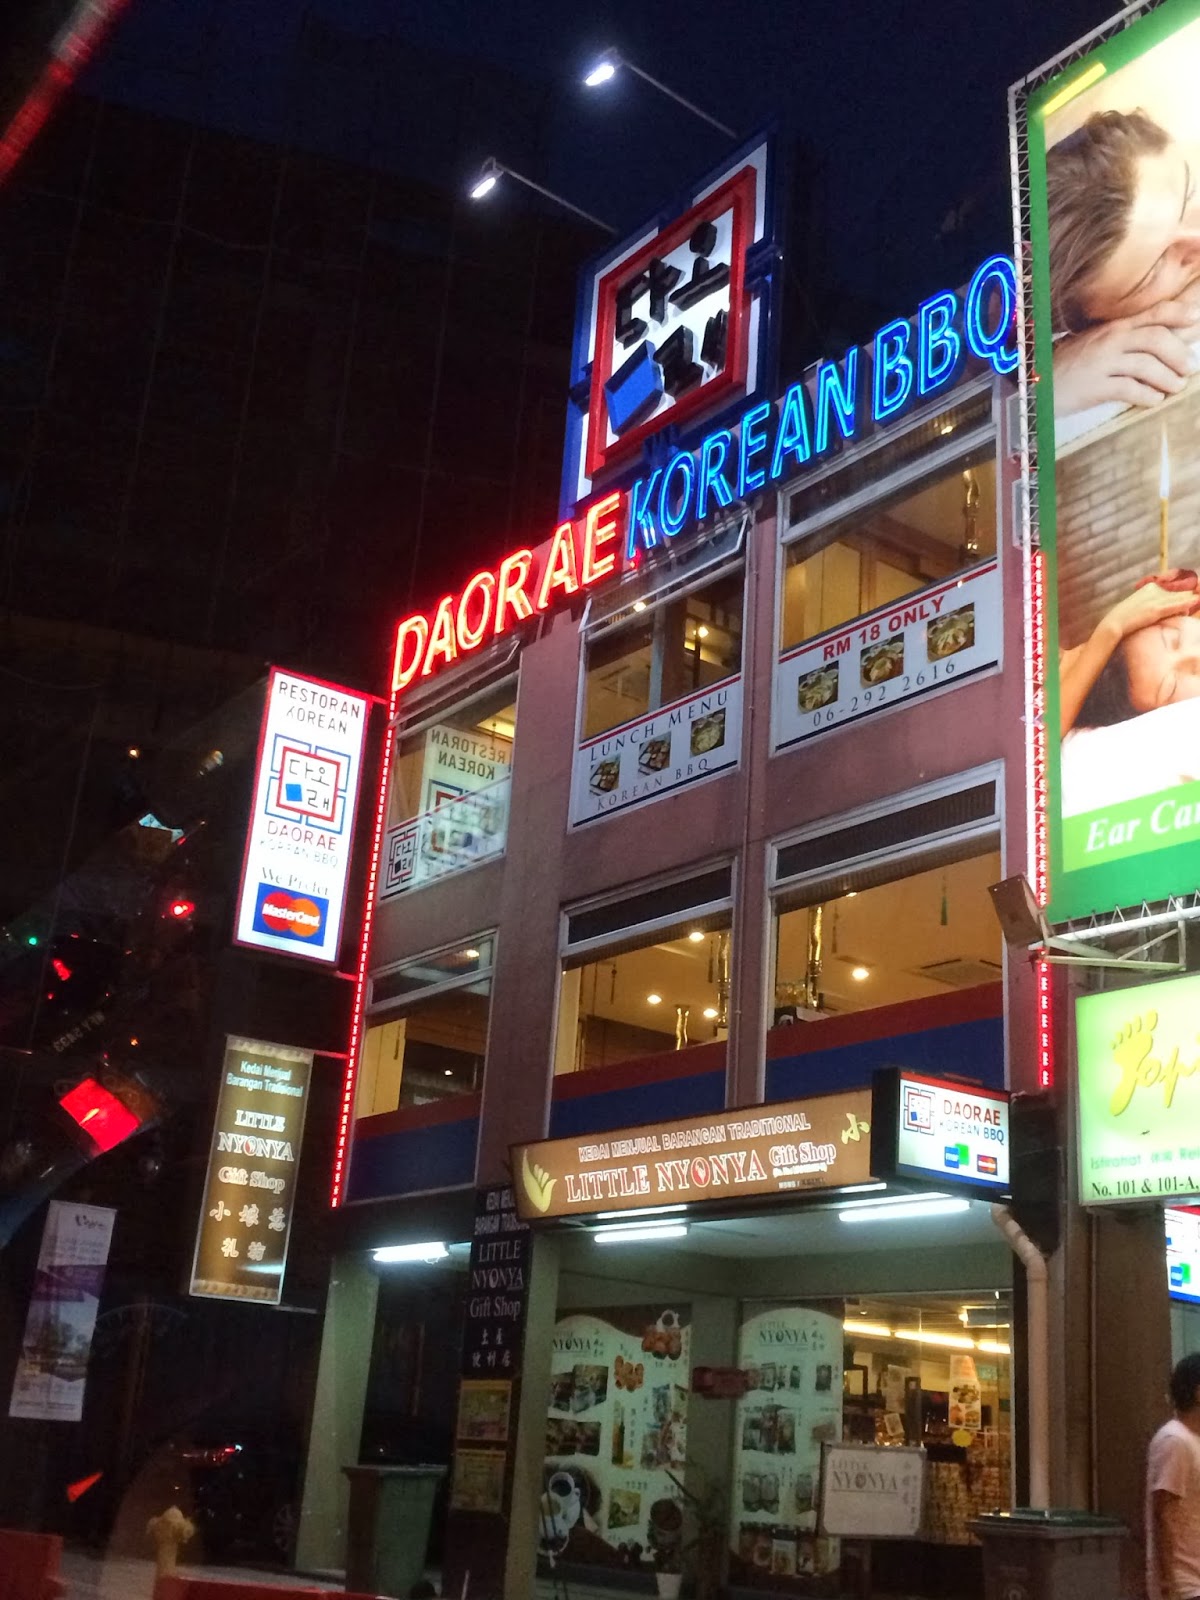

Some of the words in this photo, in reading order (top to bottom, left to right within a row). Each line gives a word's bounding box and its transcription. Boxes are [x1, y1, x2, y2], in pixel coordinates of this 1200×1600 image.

[390, 490, 624, 692] DAORAE
[627, 345, 858, 559] KOREAN
[872, 254, 1020, 425] BBQ
[823, 637, 851, 662] RM
[859, 626, 881, 645] 18
[889, 596, 944, 633] ONLY
[902, 660, 955, 692] 2616
[279, 681, 360, 719] RESTORAN
[285, 705, 348, 735] KOREAN
[590, 724, 654, 762] LUNCH
[668, 690, 728, 728] MENU
[597, 775, 663, 811] KOREAN
[675, 759, 712, 781] BBQ
[267, 820, 338, 852] DAORAE
[1085, 818, 1142, 853] Ear
[262, 866, 283, 885] We
[226, 1072, 263, 1091] Barangan
[240, 1060, 263, 1076] Kedai
[235, 1110, 286, 1133] LITTLE
[943, 1099, 1001, 1127] DAORAE
[217, 1131, 295, 1162] NYONYA
[578, 1146, 610, 1163] KEDAI
[611, 1135, 662, 1159] MENJUAL
[662, 1124, 727, 1149] BARANGAN
[727, 1113, 812, 1140] TRADITIONAL
[983, 1127, 1005, 1145] BBQ
[218, 1166, 249, 1185] Gift
[250, 1171, 286, 1194] Shop
[564, 1165, 651, 1204] LITTLE
[656, 1149, 768, 1193] NYONYA
[769, 1144, 799, 1167] Gift
[798, 1142, 837, 1166] Shop
[1092, 1181, 1112, 1197] No.
[1117, 1179, 1136, 1195] 101
[1141, 1178, 1152, 1193] &
[479, 1240, 522, 1263] LITTLE
[472, 1267, 524, 1290] NYONYA
[470, 1297, 491, 1318] Gift
[493, 1295, 521, 1321] Shop
[832, 1470, 898, 1490] NYONYA
